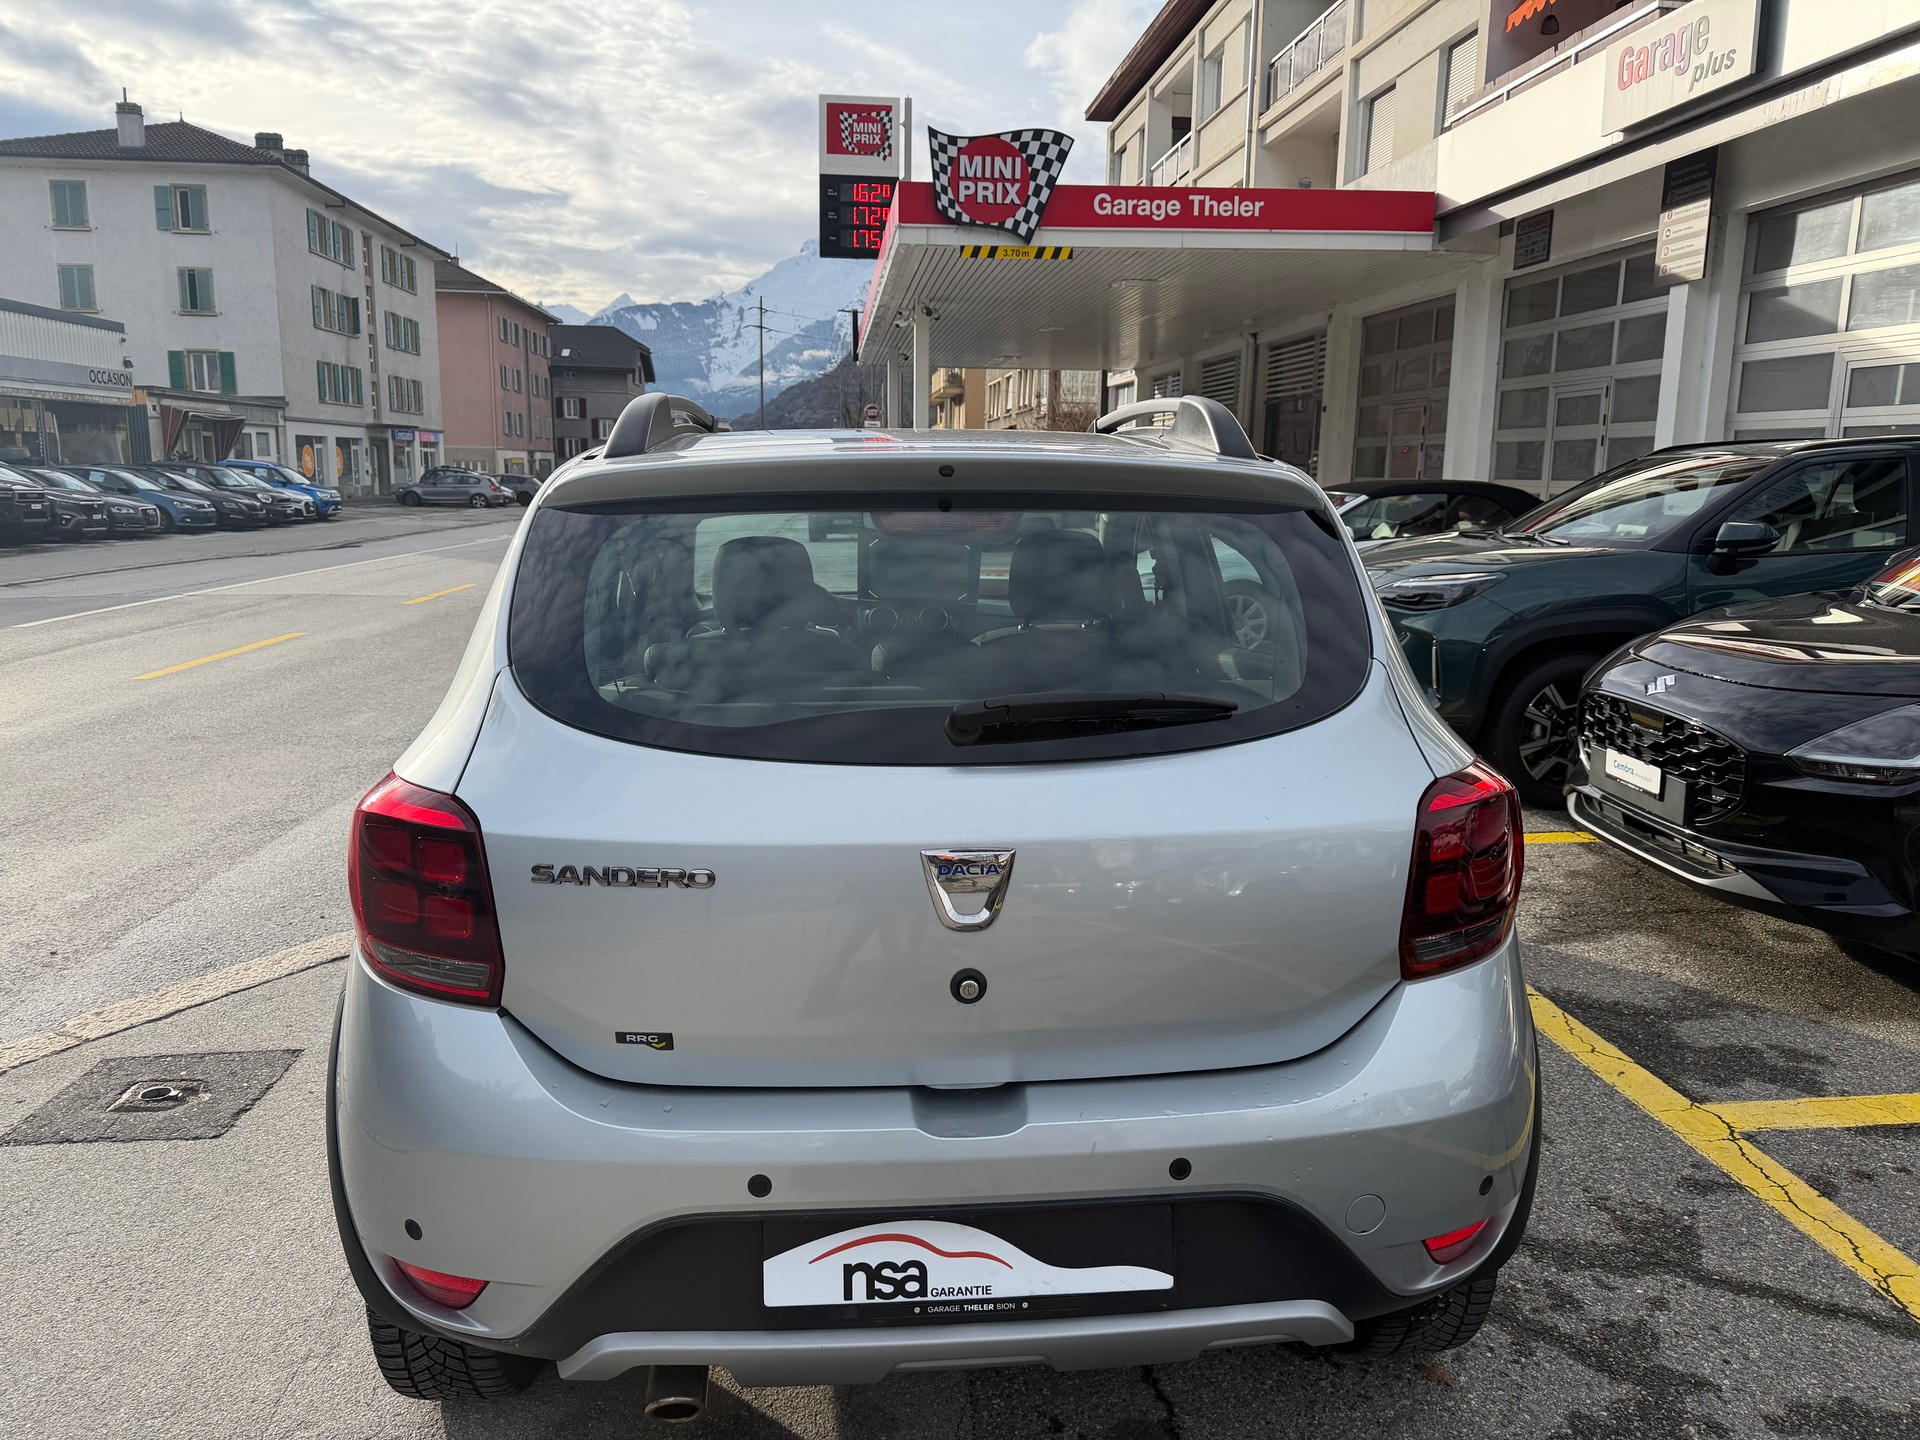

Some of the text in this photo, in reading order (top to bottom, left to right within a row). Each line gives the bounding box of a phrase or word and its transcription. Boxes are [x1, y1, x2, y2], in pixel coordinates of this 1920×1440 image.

[1618, 15, 1710, 91] Garage
[1689, 48, 1737, 92] plus
[853, 122, 881, 133] MINI
[853, 133, 881, 145] PRIX
[958, 154, 1022, 180] MINI
[958, 180, 1022, 205] PRIX
[1093, 193, 1265, 221] Garage Theler
[853, 229, 886, 249] 1.75
[88, 369, 133, 387] OCCASION
[1613, 760, 1635, 775] Cembra
[530, 863, 716, 889] SANDERO
[938, 864, 1000, 876] DACIA
[625, 1034, 659, 1043] RRG
[843, 1260, 992, 1301] nsa GARANTIE
[927, 1302, 1016, 1313] GARAGE THELER SION
